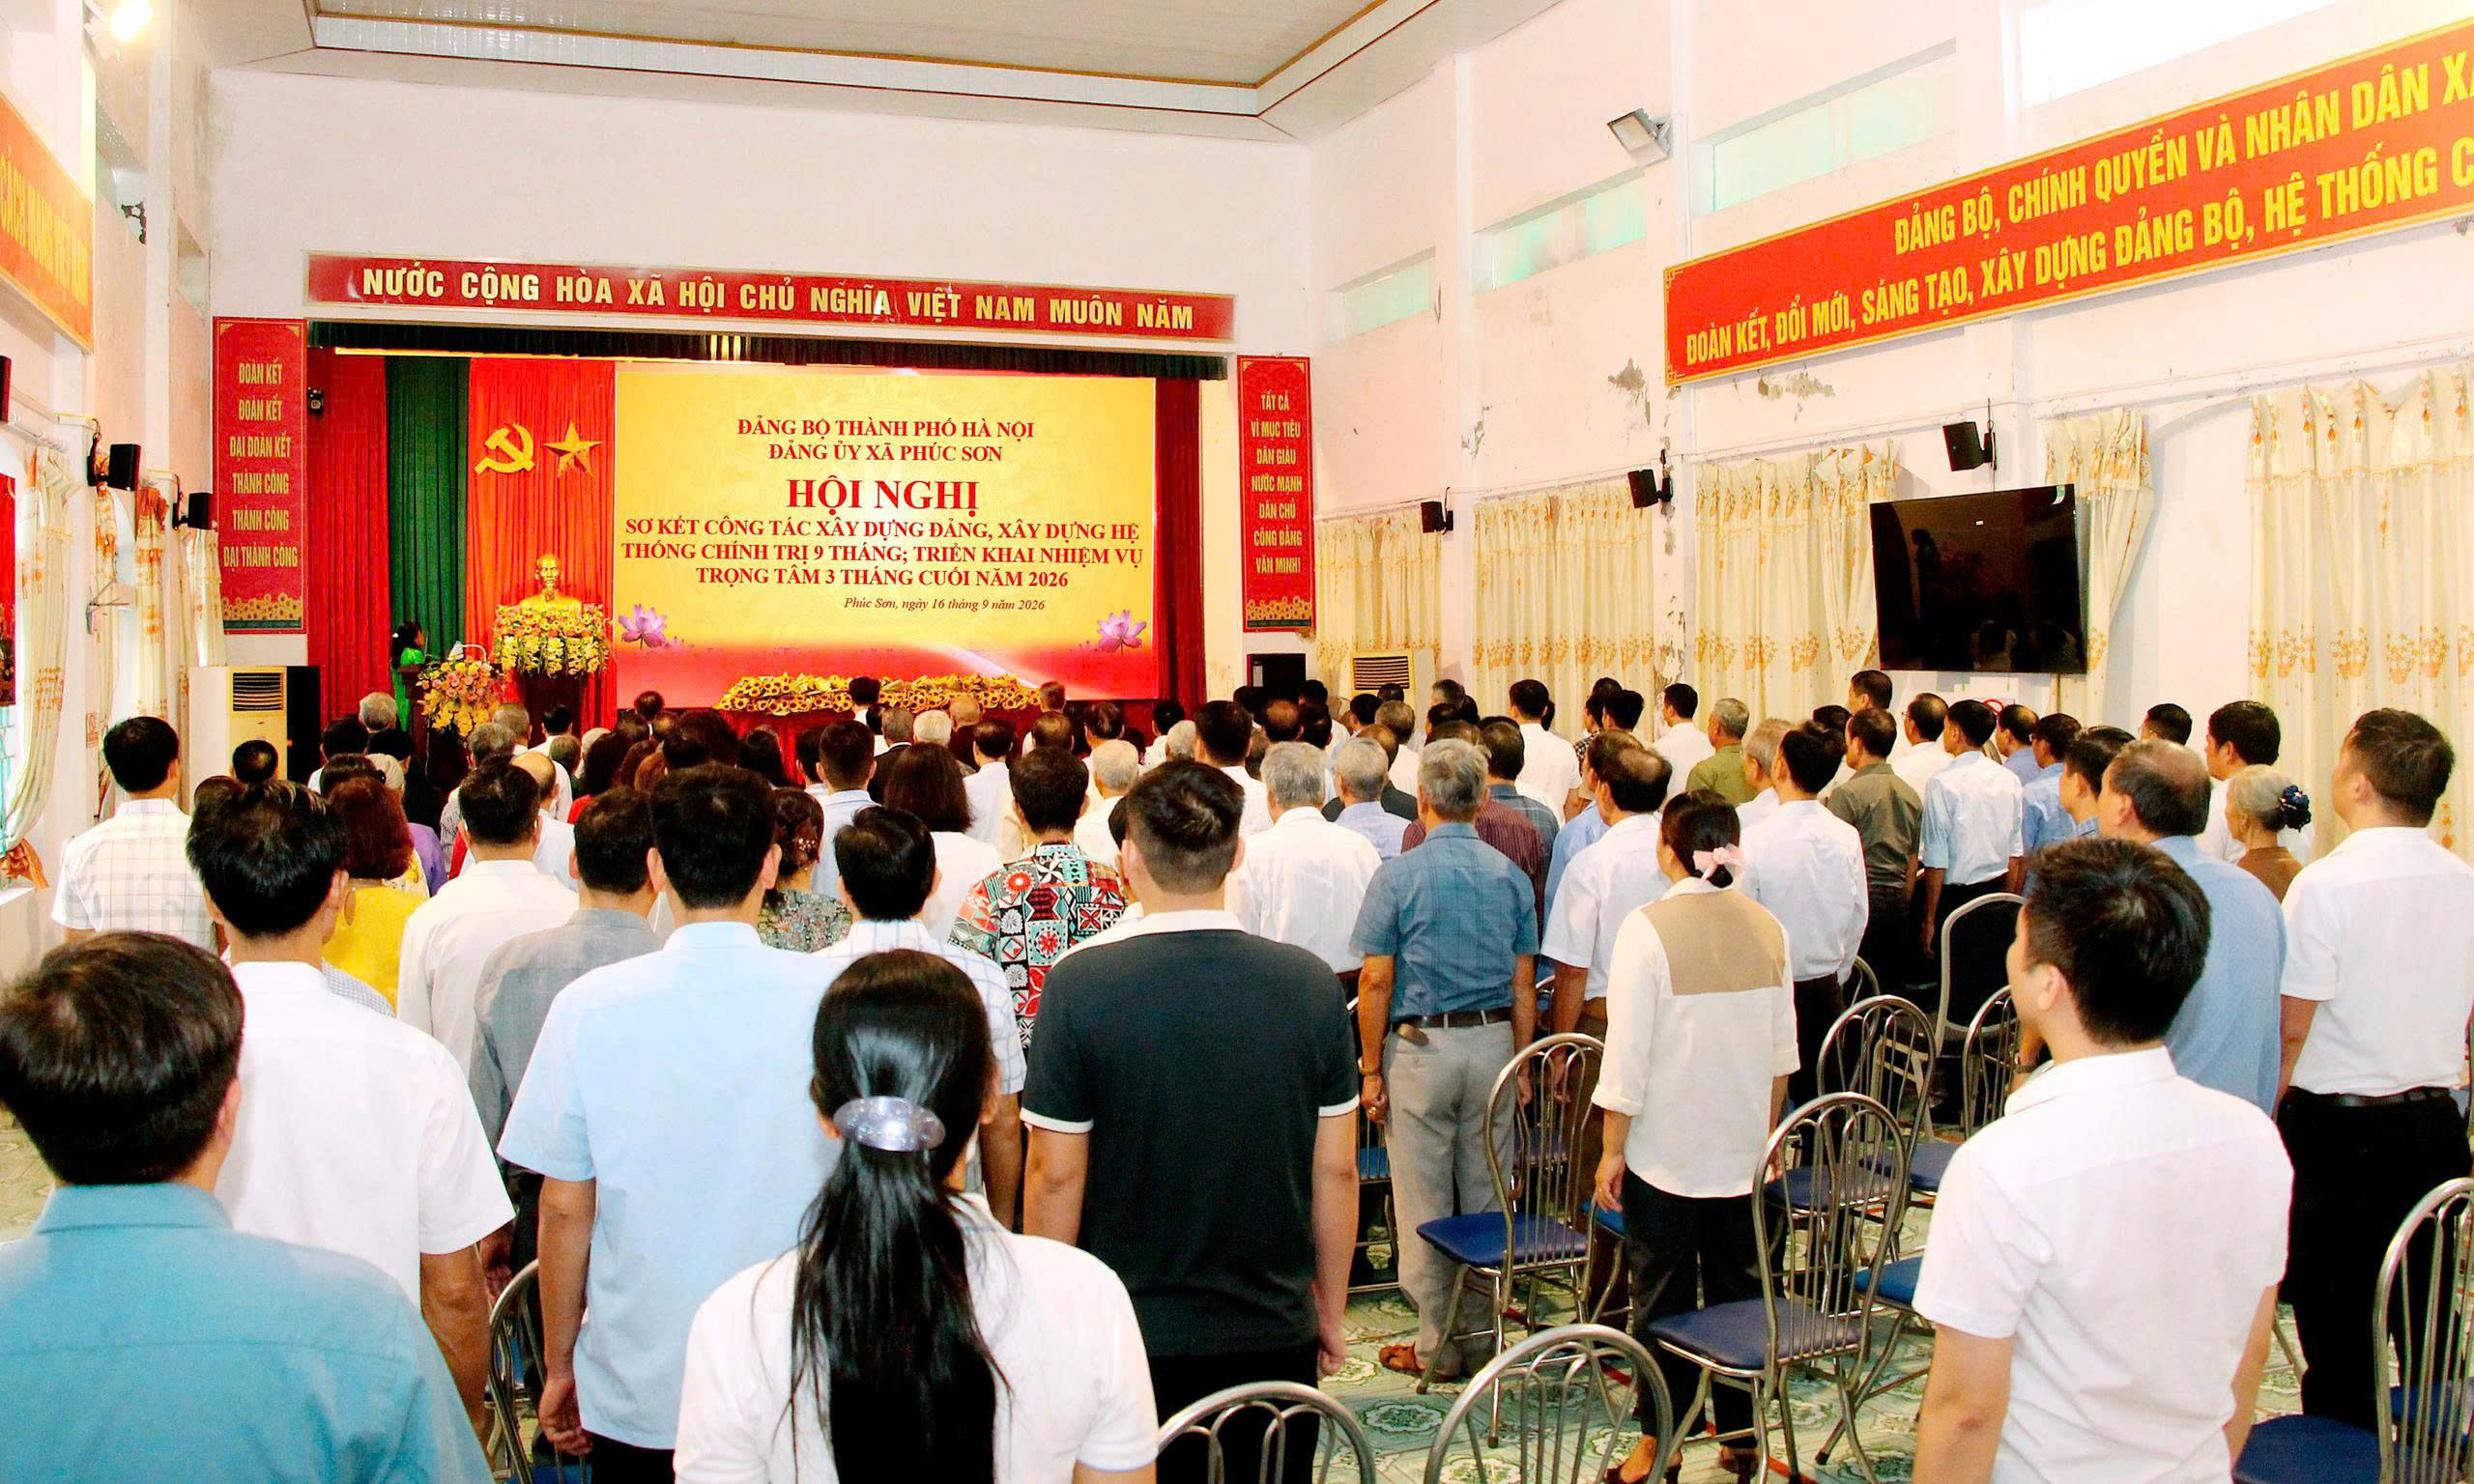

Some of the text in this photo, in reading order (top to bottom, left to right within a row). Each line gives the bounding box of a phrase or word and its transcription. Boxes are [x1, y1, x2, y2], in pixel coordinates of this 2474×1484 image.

[1894, 50, 2474, 256] ĐẢNG BỘ, CHÍNH QUYỀN VÀ NHÂN DÂN X
[1685, 320, 1732, 366] ĐOÀN
[1737, 305, 1771, 356] KẾT,
[1774, 294, 1806, 346] ĐỔI
[1812, 290, 1856, 337] MỚI,
[1861, 278, 1918, 326] SÁNG
[1924, 266, 1973, 315] TẠO,
[1980, 247, 2027, 299] XÂY
[2034, 230, 2107, 289] DỰNG
[2114, 206, 2194, 267] ĐẢNG
[2202, 186, 2254, 250] BỘ,
[2264, 171, 2307, 236] HỆ
[2316, 141, 2439, 220] THỐNG
[363, 261, 1194, 330] NƯỚC CỘNG HÒA XÃ HỘI CHỦ NGHĨA VIỆT NAM MUÔN NĂM
[239, 357, 283, 385] ĐOÀN KẾT
[239, 393, 283, 421] ĐOÀN KẾT
[1261, 389, 1290, 411] TẤT CẢ
[737, 414, 1034, 442] ĐẢNG BỘ THÀNH PHỐ HÀ NỘI
[1251, 417, 1301, 442] VÌ MỤC TIÊU
[230, 430, 291, 462] ĐẠI ĐOÀN KẾT
[768, 440, 1002, 462] ĐẢNG ỦY XÃ PHÚC SƠN
[1256, 445, 1296, 465] DÂN GIÀU
[232, 468, 289, 494] THÀNH CÔNG
[1251, 472, 1302, 495] NƯỚC MẠNH
[787, 474, 980, 517] HỘI NGHỊ
[1259, 498, 1295, 519] DÂN CHỦ
[232, 504, 289, 530] THÀNH CÔNG
[625, 515, 1139, 544] SƠ KẾT CÔNG TÁC XÂY DỰNG ĐẢNG, XÂY DỰNG HỆ
[1253, 524, 1303, 547] CÔNG BẰNG
[223, 541, 298, 572] ĐẠI THÀNH CÔNG
[621, 539, 1143, 568] THỐNG CHÍNH TRỊ 9 THÁNG; TRIỂN KHAI NHIỆM VỤ
[1256, 553, 1301, 574] VĂN MINH!
[696, 564, 1069, 587] TRỌNG TÂM 3 THÁNG CUỐI NĂM 2026
[844, 596, 1046, 612] Phúc Sơn, ngày 16 tháng 9 năm 2026
